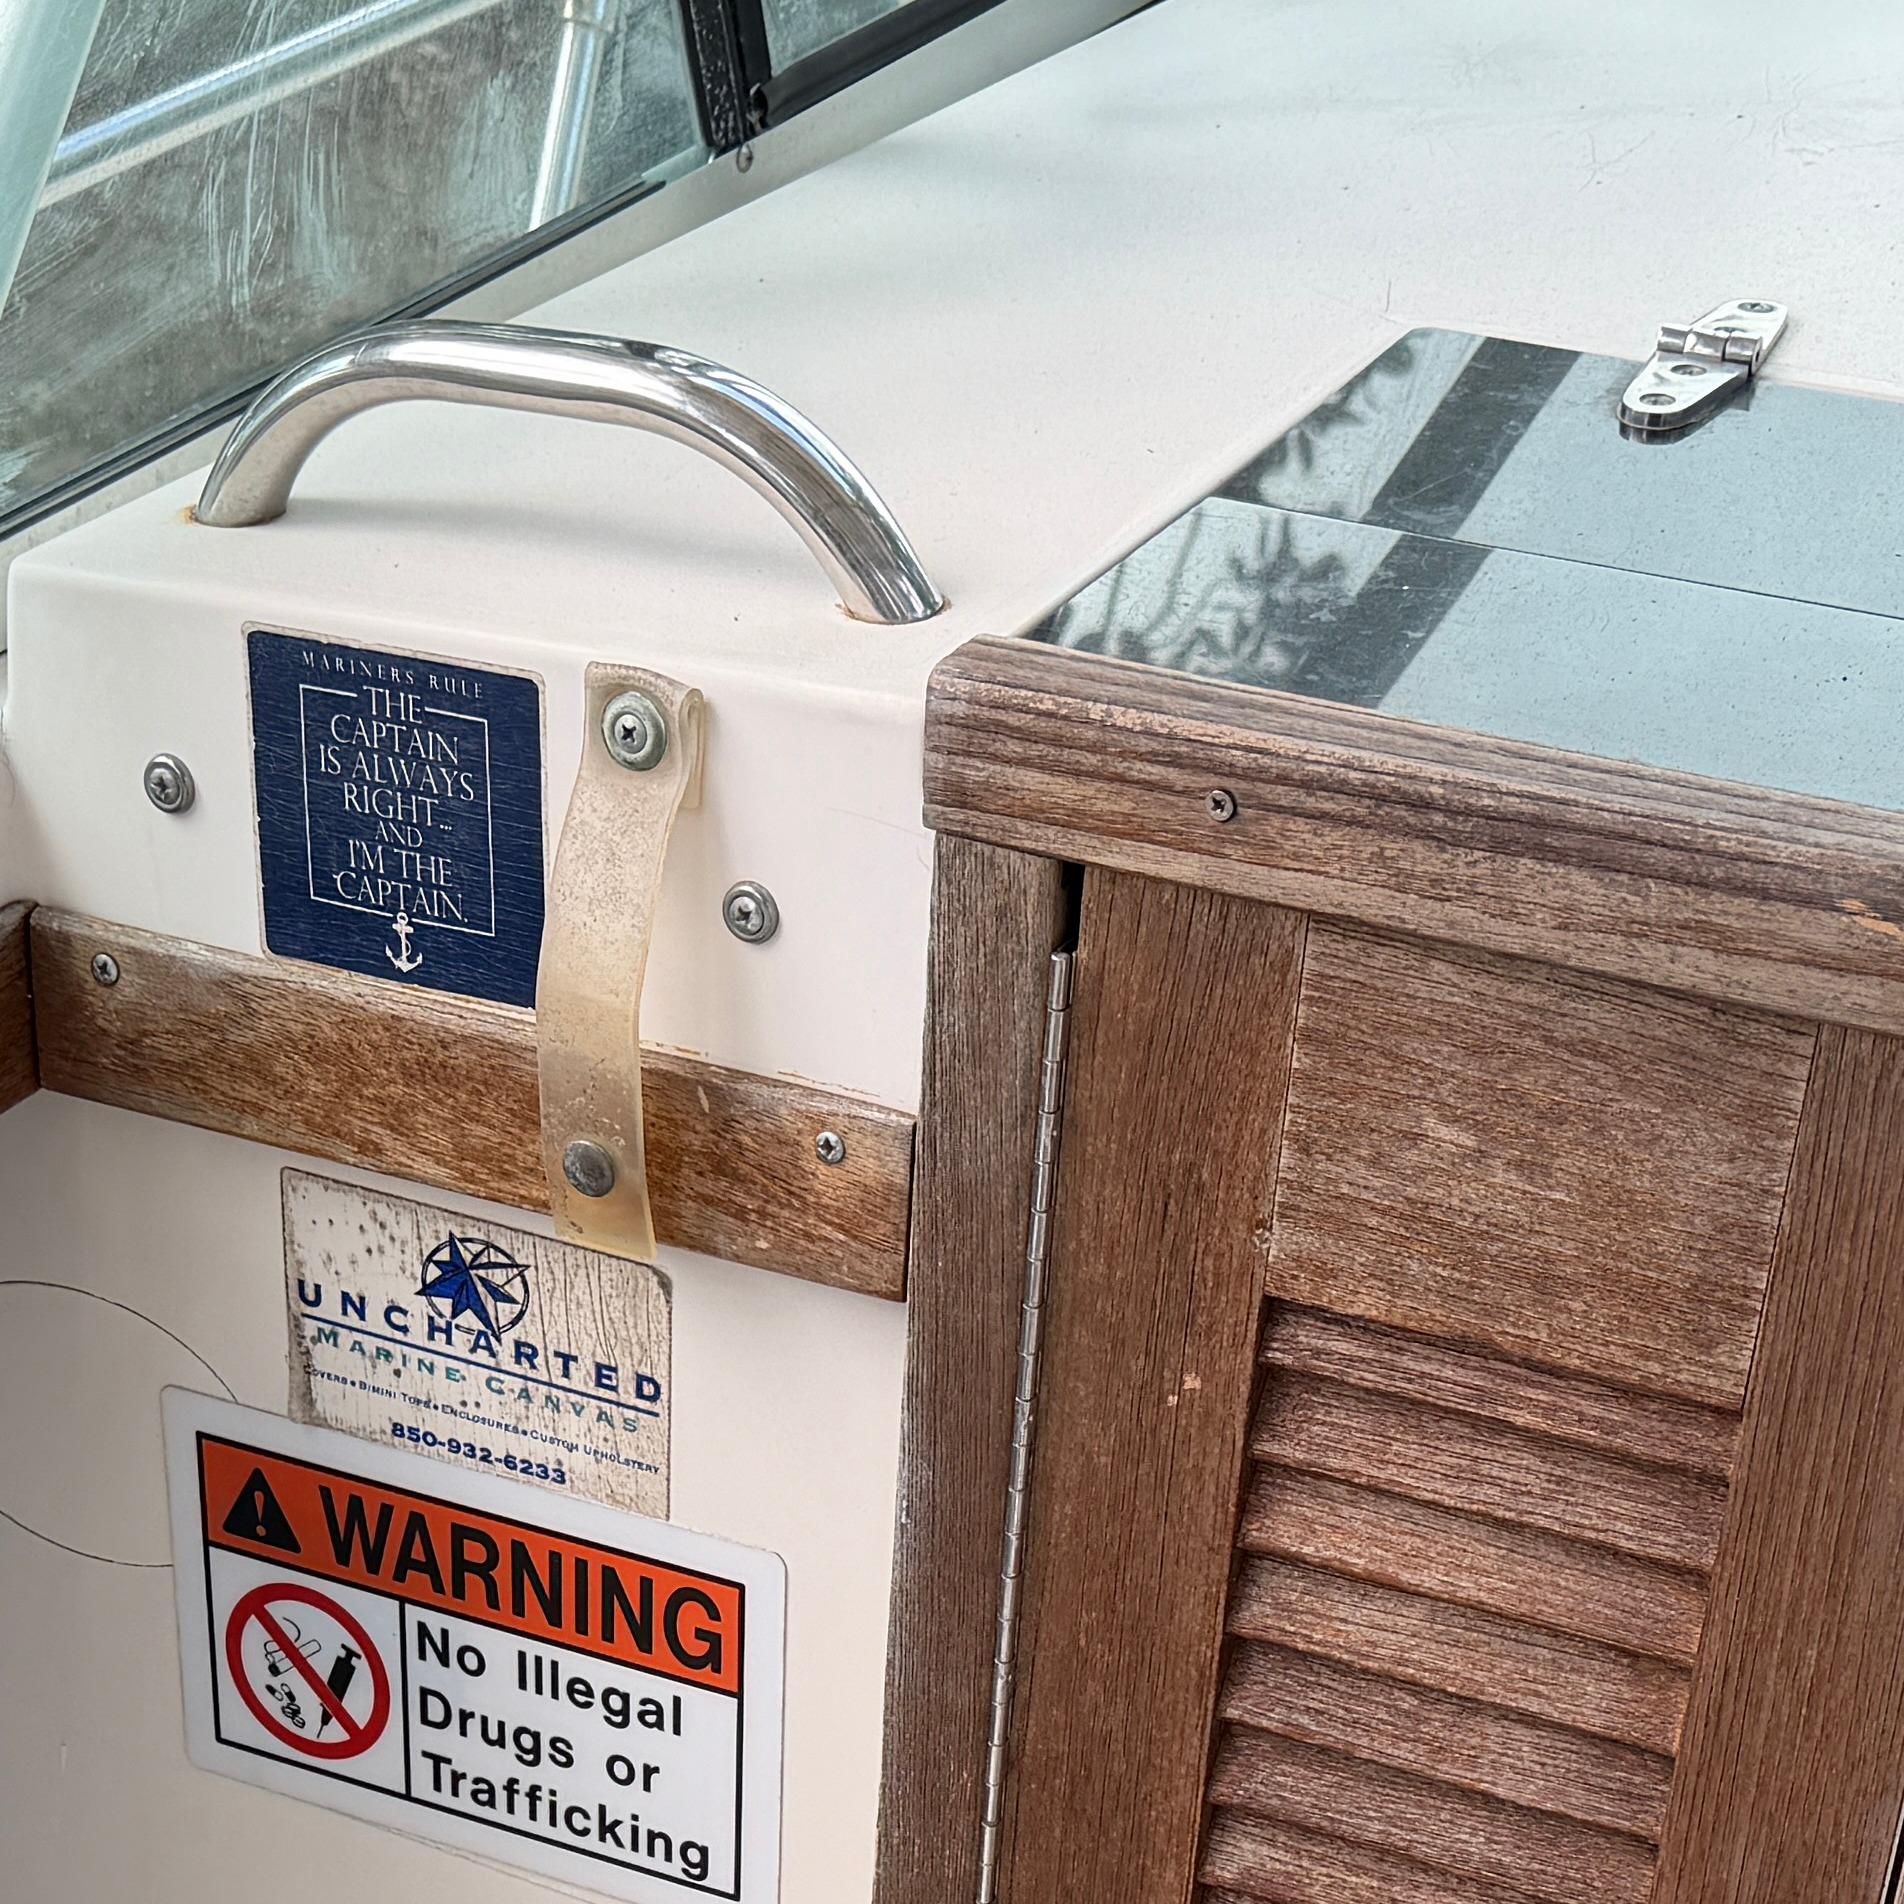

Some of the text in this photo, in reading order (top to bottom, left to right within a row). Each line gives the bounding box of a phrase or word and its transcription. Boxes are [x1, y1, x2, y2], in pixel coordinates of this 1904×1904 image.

[302, 651, 484, 698] MARINERS RULE
[363, 687, 423, 724] THE
[330, 714, 458, 764] CAPTAIN
[319, 744, 475, 801] IS ALWAYS
[348, 840, 452, 886] I'M THE
[374, 820, 423, 848] AND
[336, 871, 468, 922] CAPTAIN.
[297, 1279, 662, 1402] UNCHARTED
[317, 1326, 638, 1433] MARINE CANVAS
[359, 1381, 396, 1399] BIMINI
[401, 1392, 432, 1410] TOPS
[441, 1404, 519, 1434] ENCLOSURES
[530, 1430, 579, 1452] CUSTOM
[584, 1445, 659, 1474] UPHOLSTERY
[391, 1422, 567, 1486] 850-932-6233
[318, 1485, 723, 1674] WARNING
[417, 1621, 682, 1736] No Illegal
[419, 1688, 660, 1793] Drugs or
[422, 1751, 710, 1882] Trafficking
